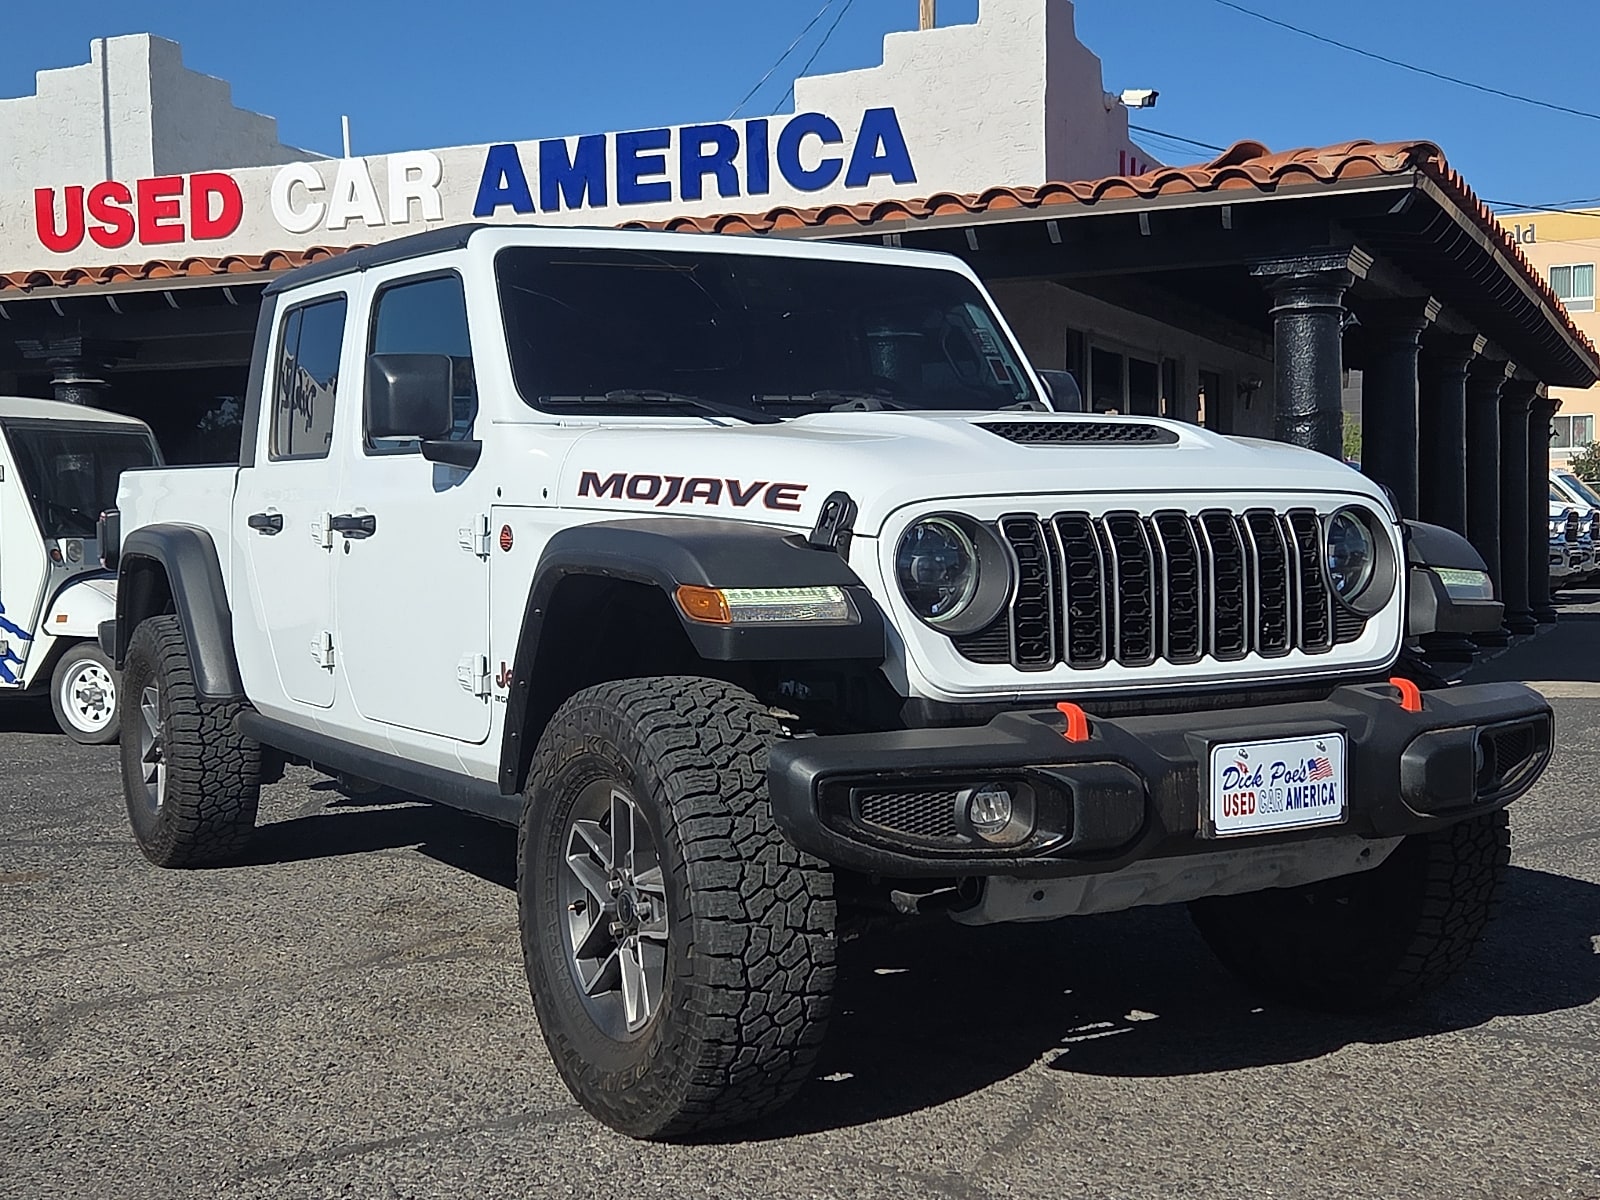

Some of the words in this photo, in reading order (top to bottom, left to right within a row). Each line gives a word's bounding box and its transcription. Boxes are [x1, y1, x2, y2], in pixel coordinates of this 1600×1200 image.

[34, 172, 244, 253] USED
[270, 151, 444, 234] CAR
[473, 107, 918, 218] AMERICA
[577, 471, 809, 512] MOJAVE
[495, 661, 514, 689] Je
[1222, 763, 1264, 791] Dick
[1269, 758, 1309, 787] Poe's
[1223, 791, 1256, 817] USED
[1258, 788, 1285, 816] CAR
[1286, 782, 1337, 811] AMERICA
